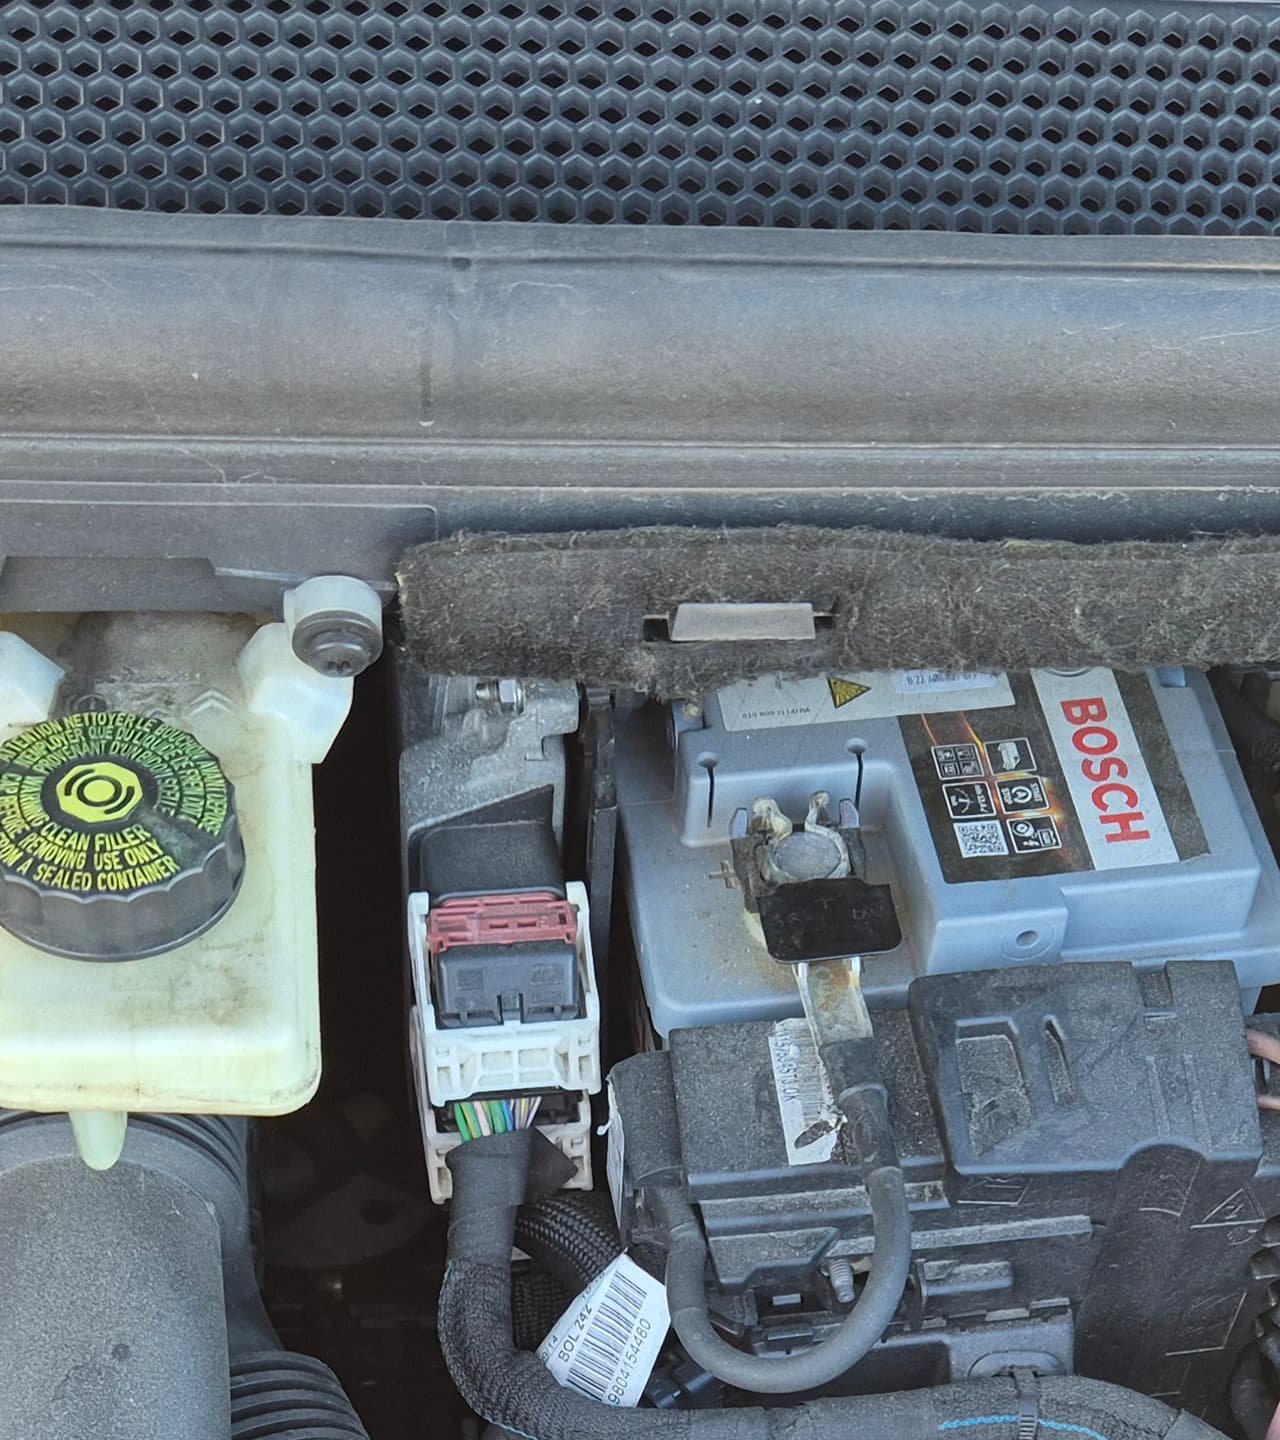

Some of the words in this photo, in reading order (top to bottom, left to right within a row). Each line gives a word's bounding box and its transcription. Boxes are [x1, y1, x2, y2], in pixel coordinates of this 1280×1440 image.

[63, 711, 136, 730] NETTOYER
[135, 717, 157, 732] LE
[88, 725, 113, 741] QUE
[115, 727, 134, 742] DU
[31, 740, 107, 776] PROVENANT
[1060, 696, 1151, 843] BOSCH
[20, 774, 51, 828] WARNING
[40, 821, 91, 851] CLEAN
[94, 823, 152, 852] FILLER
[17, 831, 88, 871] REMOVING
[93, 851, 124, 871] USE
[123, 837, 164, 867] ONLY
[15, 856, 34, 876] A
[31, 862, 93, 892] SEALED
[96, 854, 182, 892] CONTAINER
[607, 1317, 652, 1406] 9804154480
